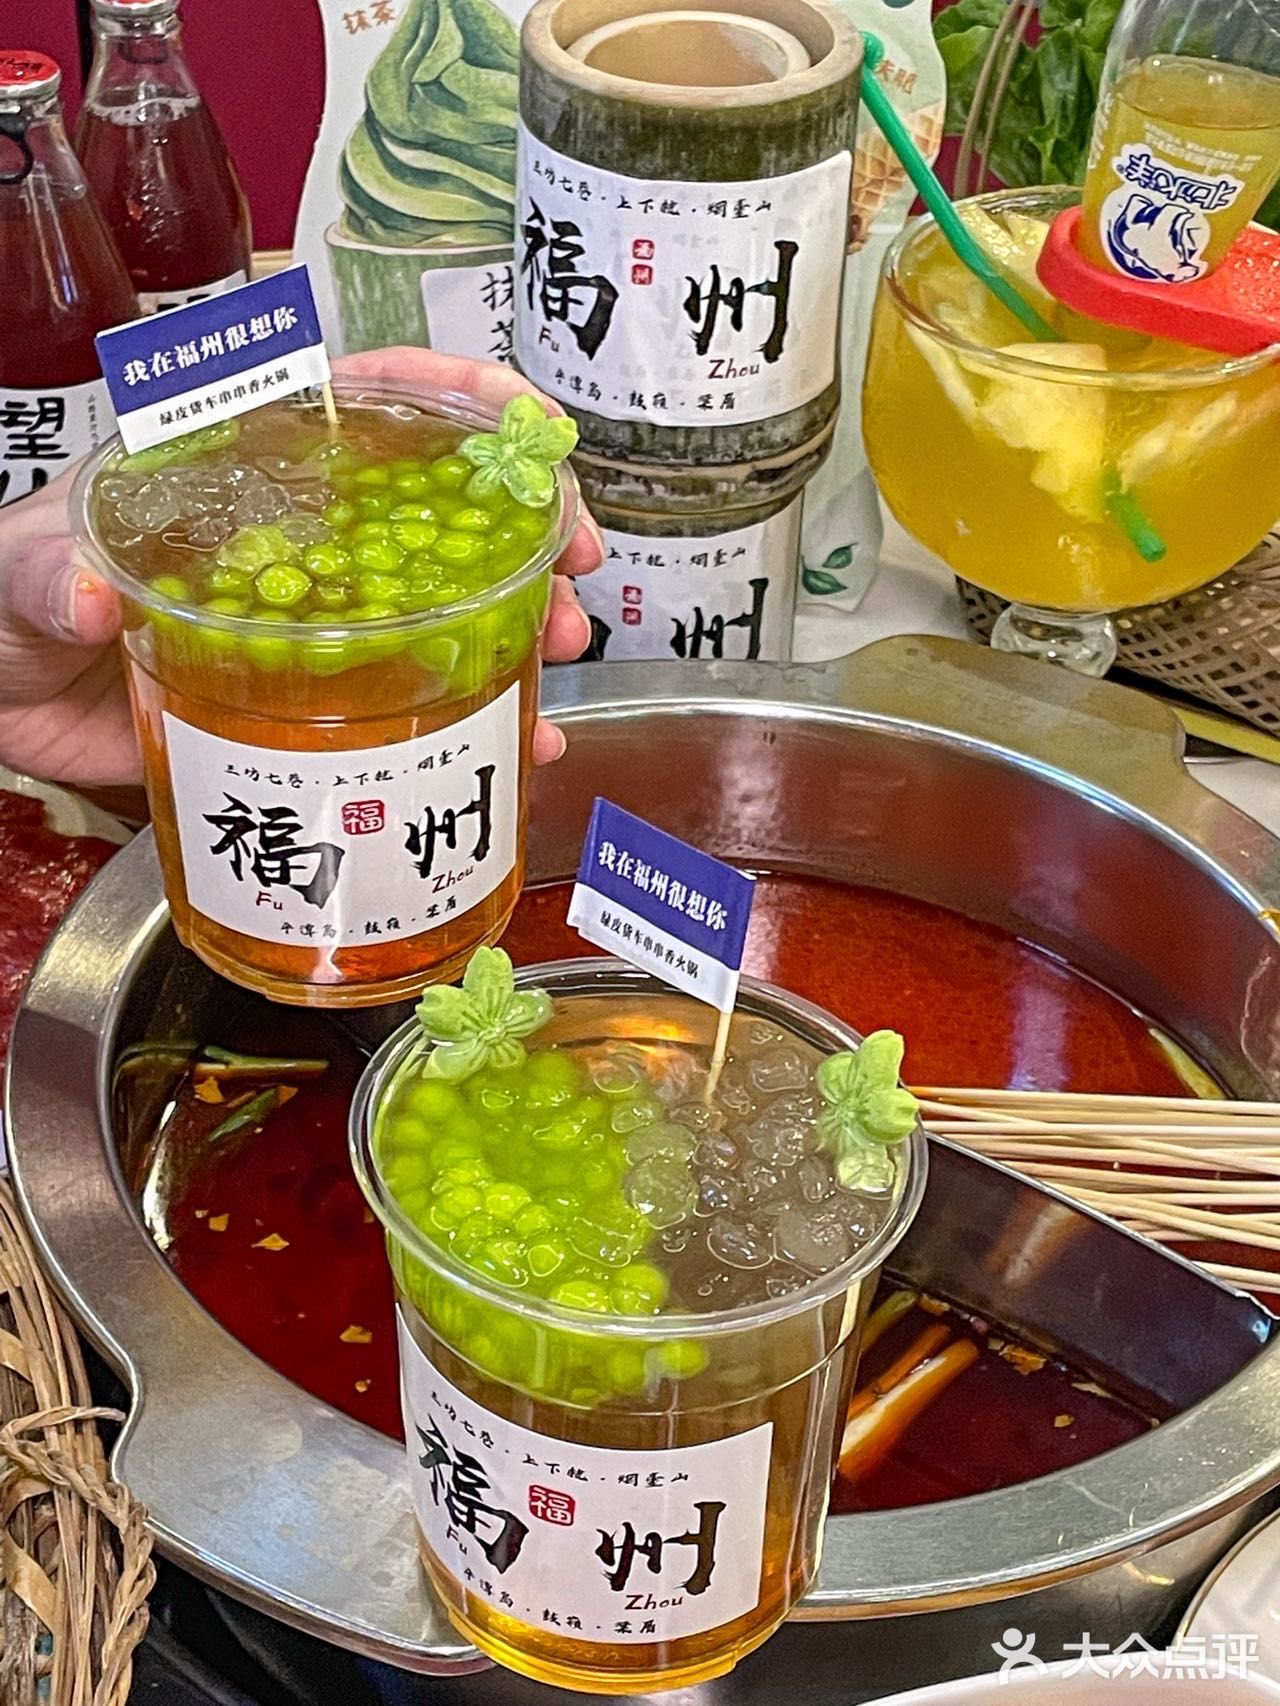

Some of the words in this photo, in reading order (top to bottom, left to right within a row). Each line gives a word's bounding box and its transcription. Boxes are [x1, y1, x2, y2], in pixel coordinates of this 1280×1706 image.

[1123, 153, 1238, 210] 北冰洋
[122, 305, 299, 387] 我在福州很想你
[538, 326, 561, 353] Fu
[707, 358, 760, 380] Zhou
[158, 367, 290, 426] 绿皮货车串串香火锅
[342, 800, 385, 835] 福
[255, 890, 284, 911] Fu
[431, 864, 475, 894] Zhou
[597, 840, 729, 932] 我在福州很想你
[599, 910, 700, 980] 绿皮货车串串香火锅
[529, 1485, 576, 1526] 福
[446, 1526, 469, 1556] Fu
[624, 1593, 684, 1611] Zhou
